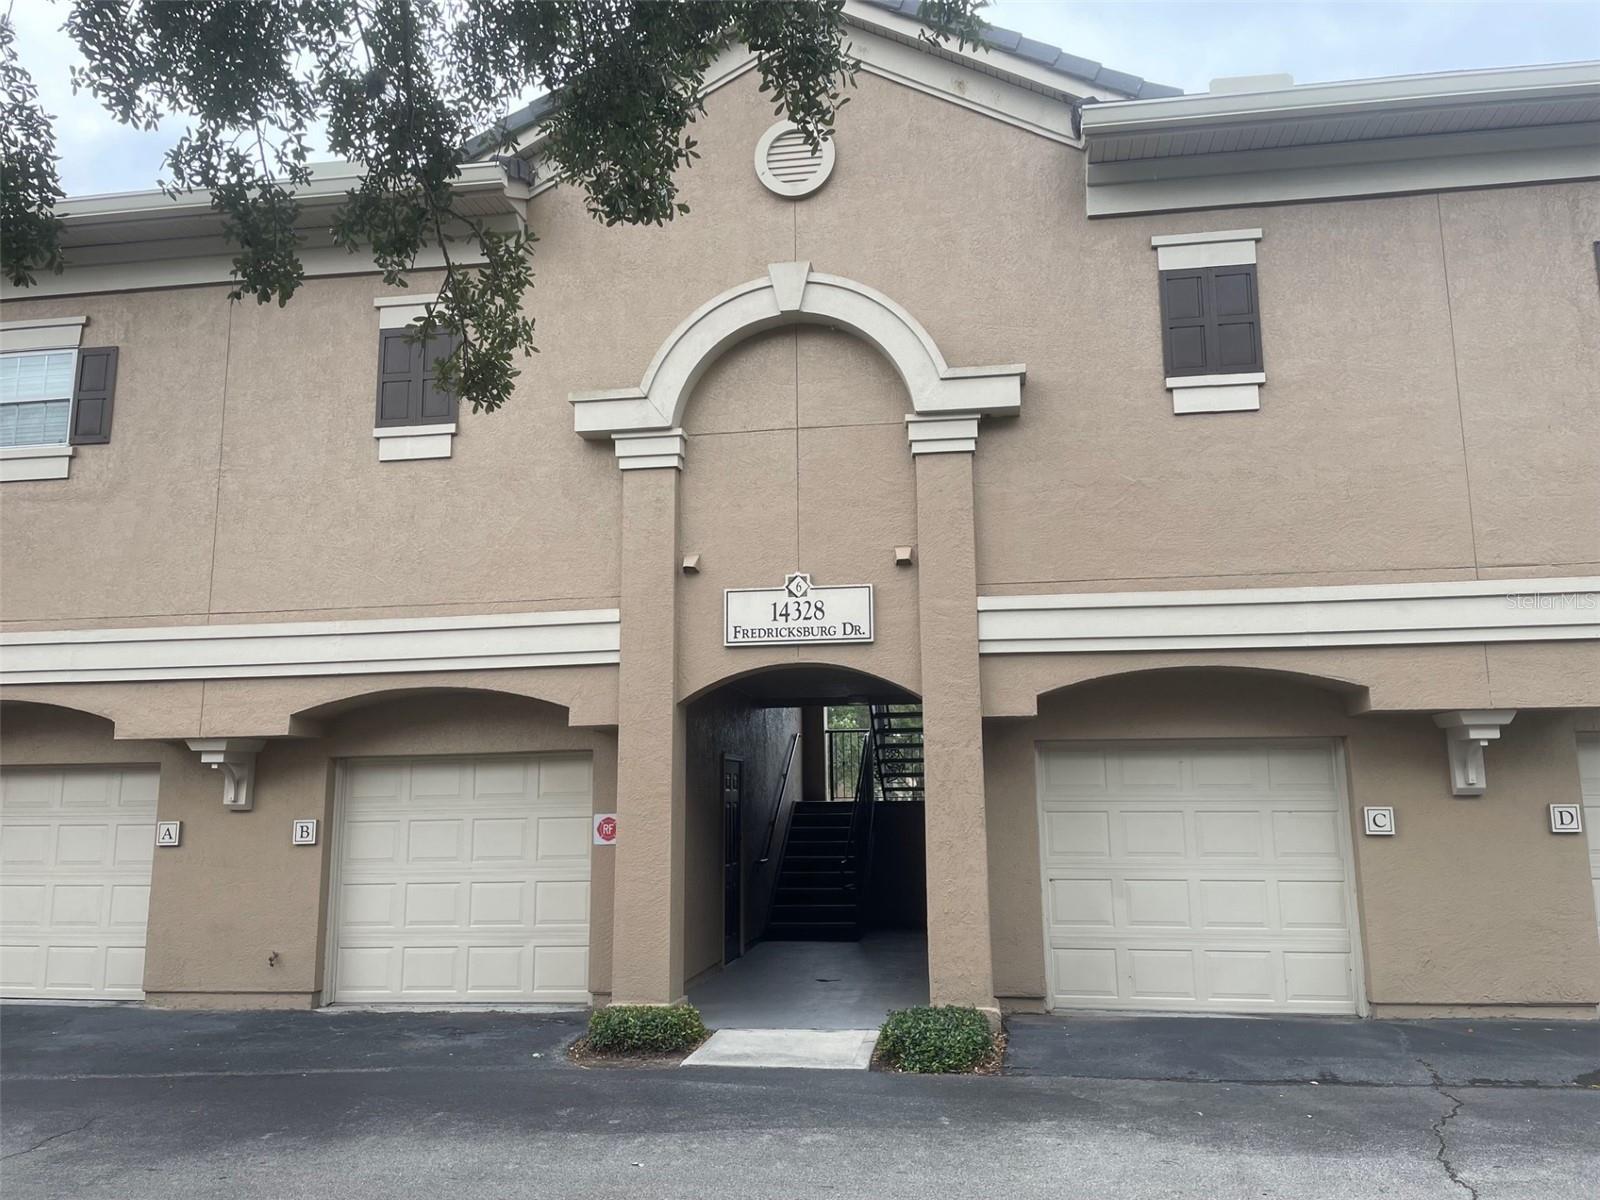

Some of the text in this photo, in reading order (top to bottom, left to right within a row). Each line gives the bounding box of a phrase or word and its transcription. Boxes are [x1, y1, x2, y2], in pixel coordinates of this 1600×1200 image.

[795, 581, 802, 592] 6
[771, 600, 825, 623] 14328
[1372, 813, 1387, 828] C
[1558, 810, 1574, 826] D
[161, 827, 173, 840] A
[299, 825, 310, 839] B
[602, 823, 615, 835] RF
